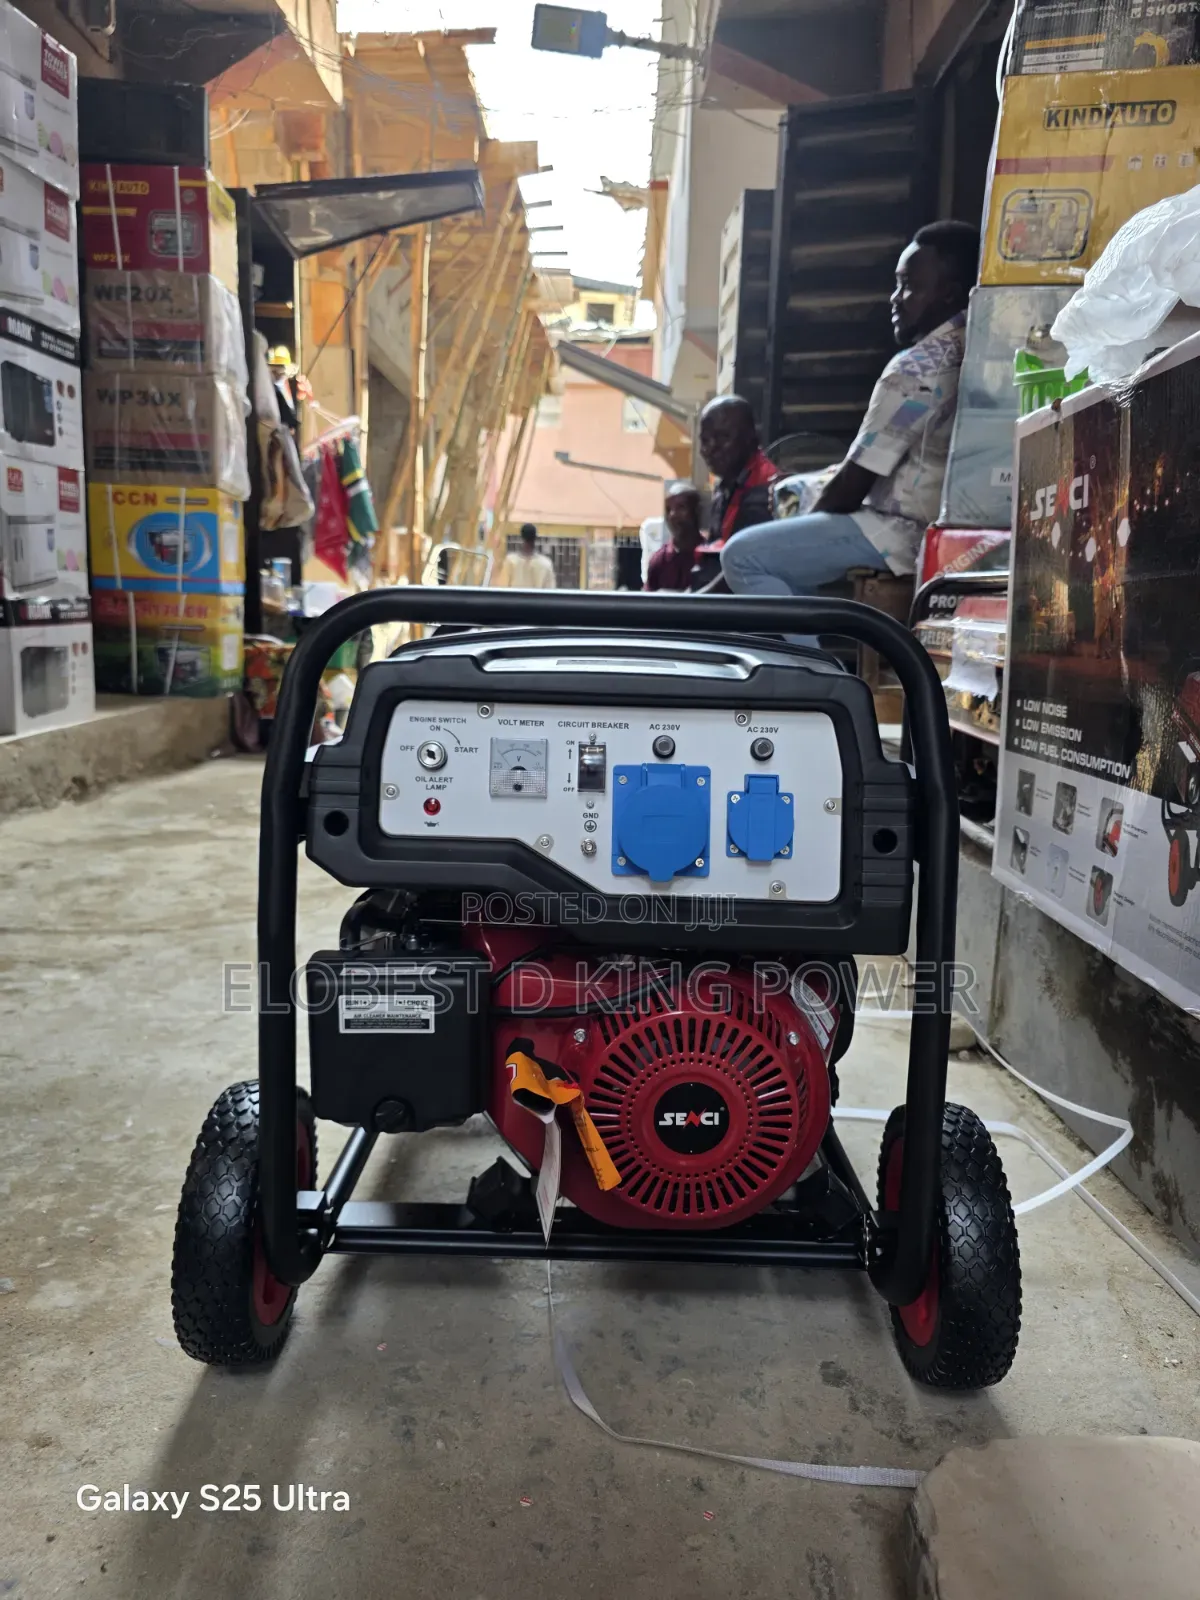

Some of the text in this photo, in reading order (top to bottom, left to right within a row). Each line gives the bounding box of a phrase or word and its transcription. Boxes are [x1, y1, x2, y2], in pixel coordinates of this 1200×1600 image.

[97, 387, 181, 407] WP30X
[112, 491, 157, 506] CCN
[1030, 474, 1089, 521] SENCI
[1024, 699, 1067, 718] LOW NOISE
[519, 719, 544, 727] METER
[591, 722, 629, 730] BREAKER
[760, 726, 779, 734] 230V
[1022, 718, 1083, 743] LOW EMISSION
[1021, 737, 1130, 779] LOW FUEL CONSUMPTION
[659, 1108, 719, 1128] SENCI
